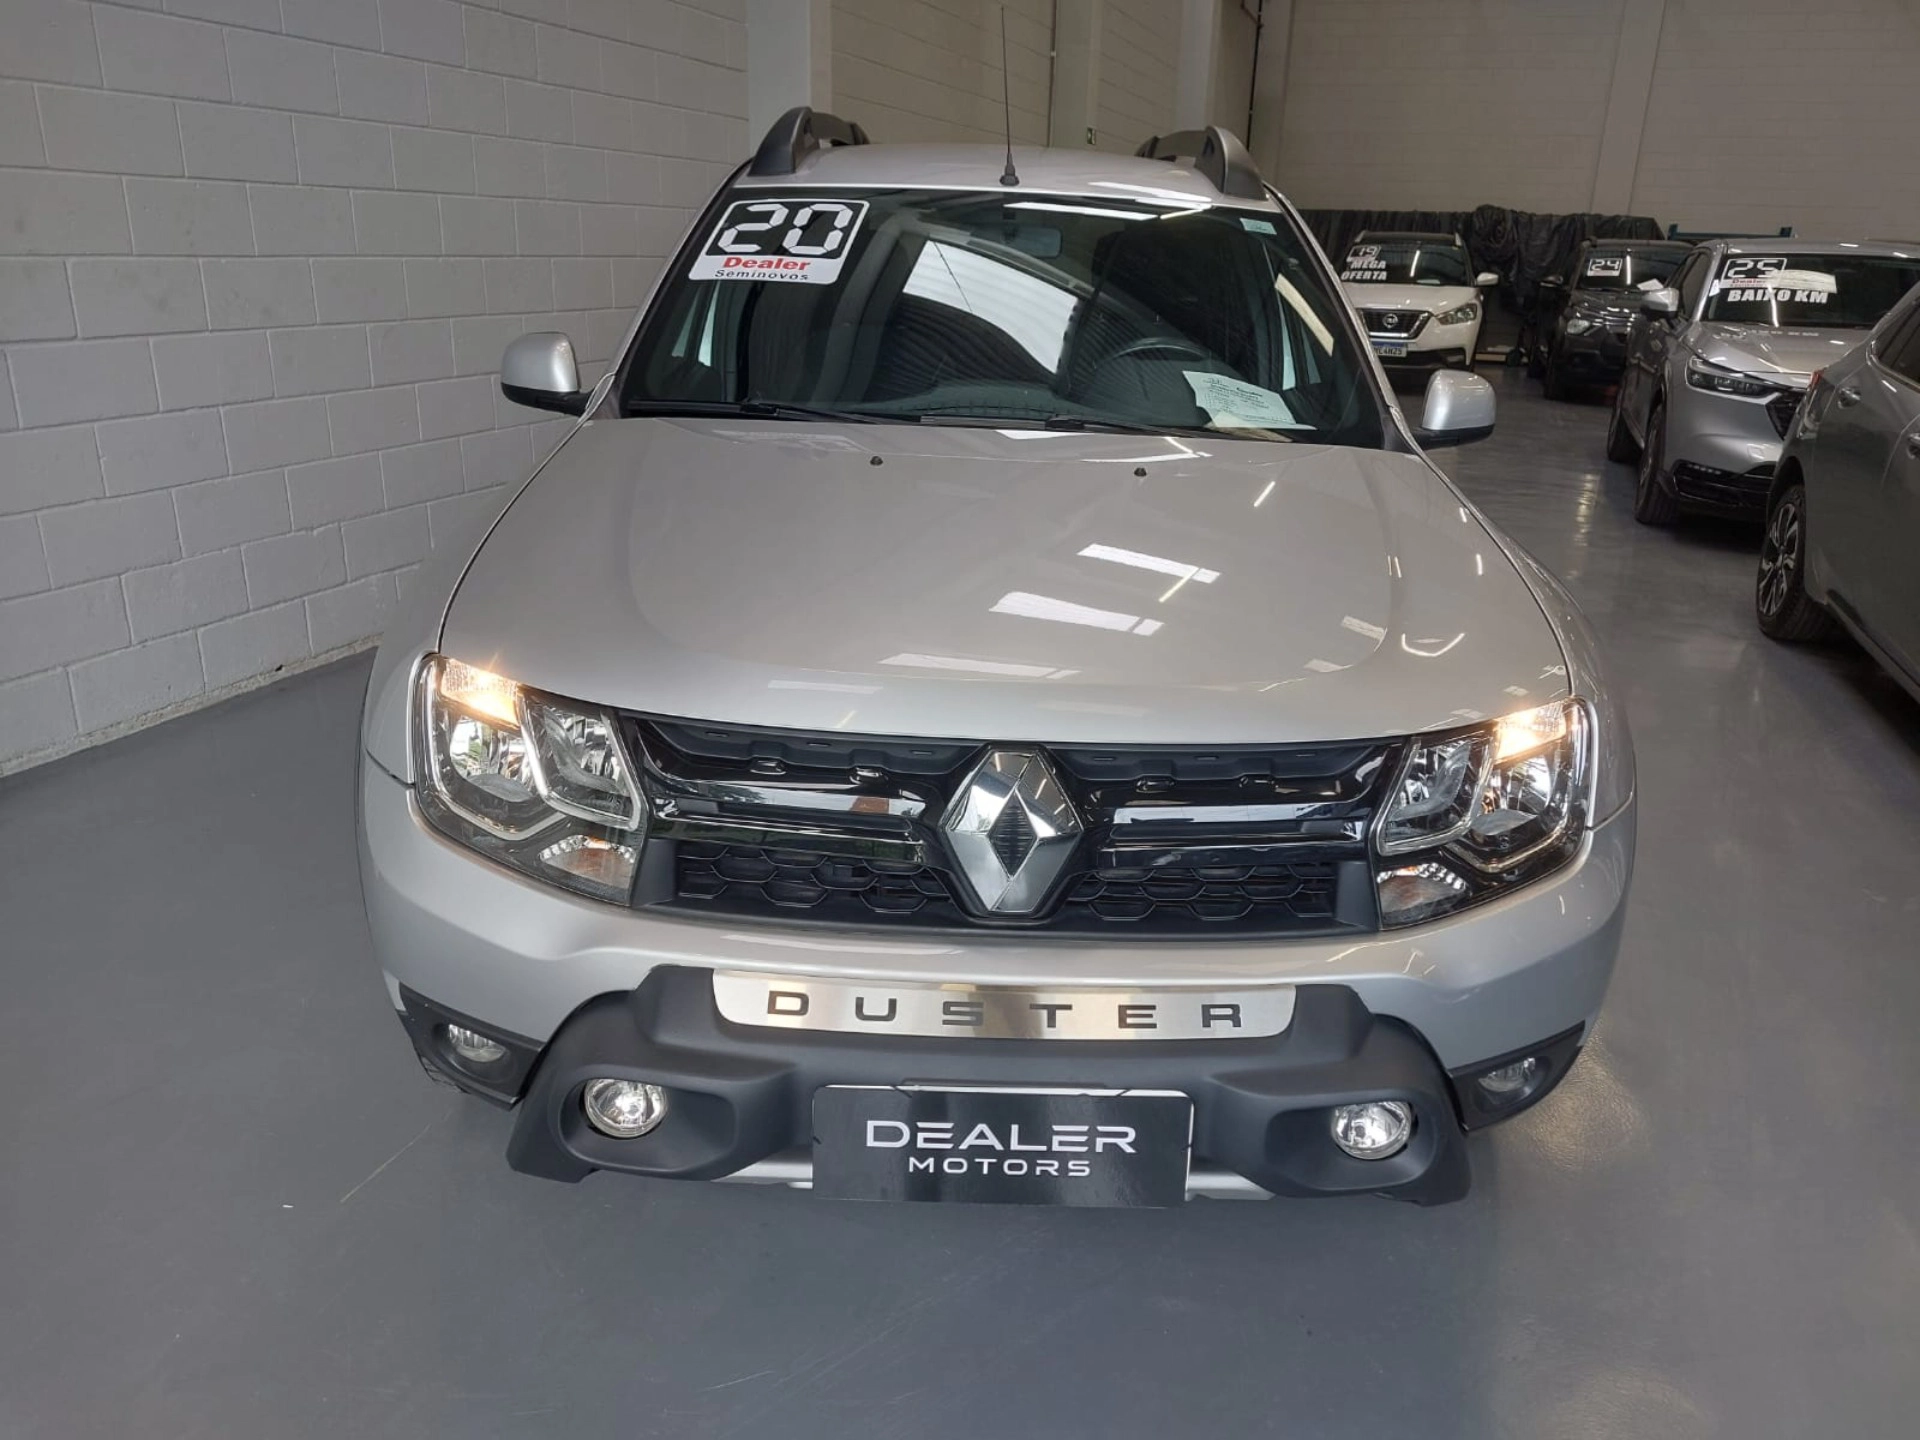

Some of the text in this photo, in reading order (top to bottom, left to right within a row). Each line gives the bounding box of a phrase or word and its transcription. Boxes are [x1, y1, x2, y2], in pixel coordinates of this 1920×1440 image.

[718, 203, 854, 256] 20
[723, 256, 811, 271] Dealer
[1350, 260, 1387, 270] MEGA
[1591, 259, 1620, 271] 24
[1727, 259, 1779, 278] 25
[714, 269, 810, 281] Seminovos
[1340, 270, 1388, 281] OFERTA
[1727, 289, 1829, 304] BAIXO KM
[767, 989, 1243, 1030] DUSTER
[865, 1119, 1138, 1154] DEALER
[908, 1156, 1091, 1178] MOTORS
